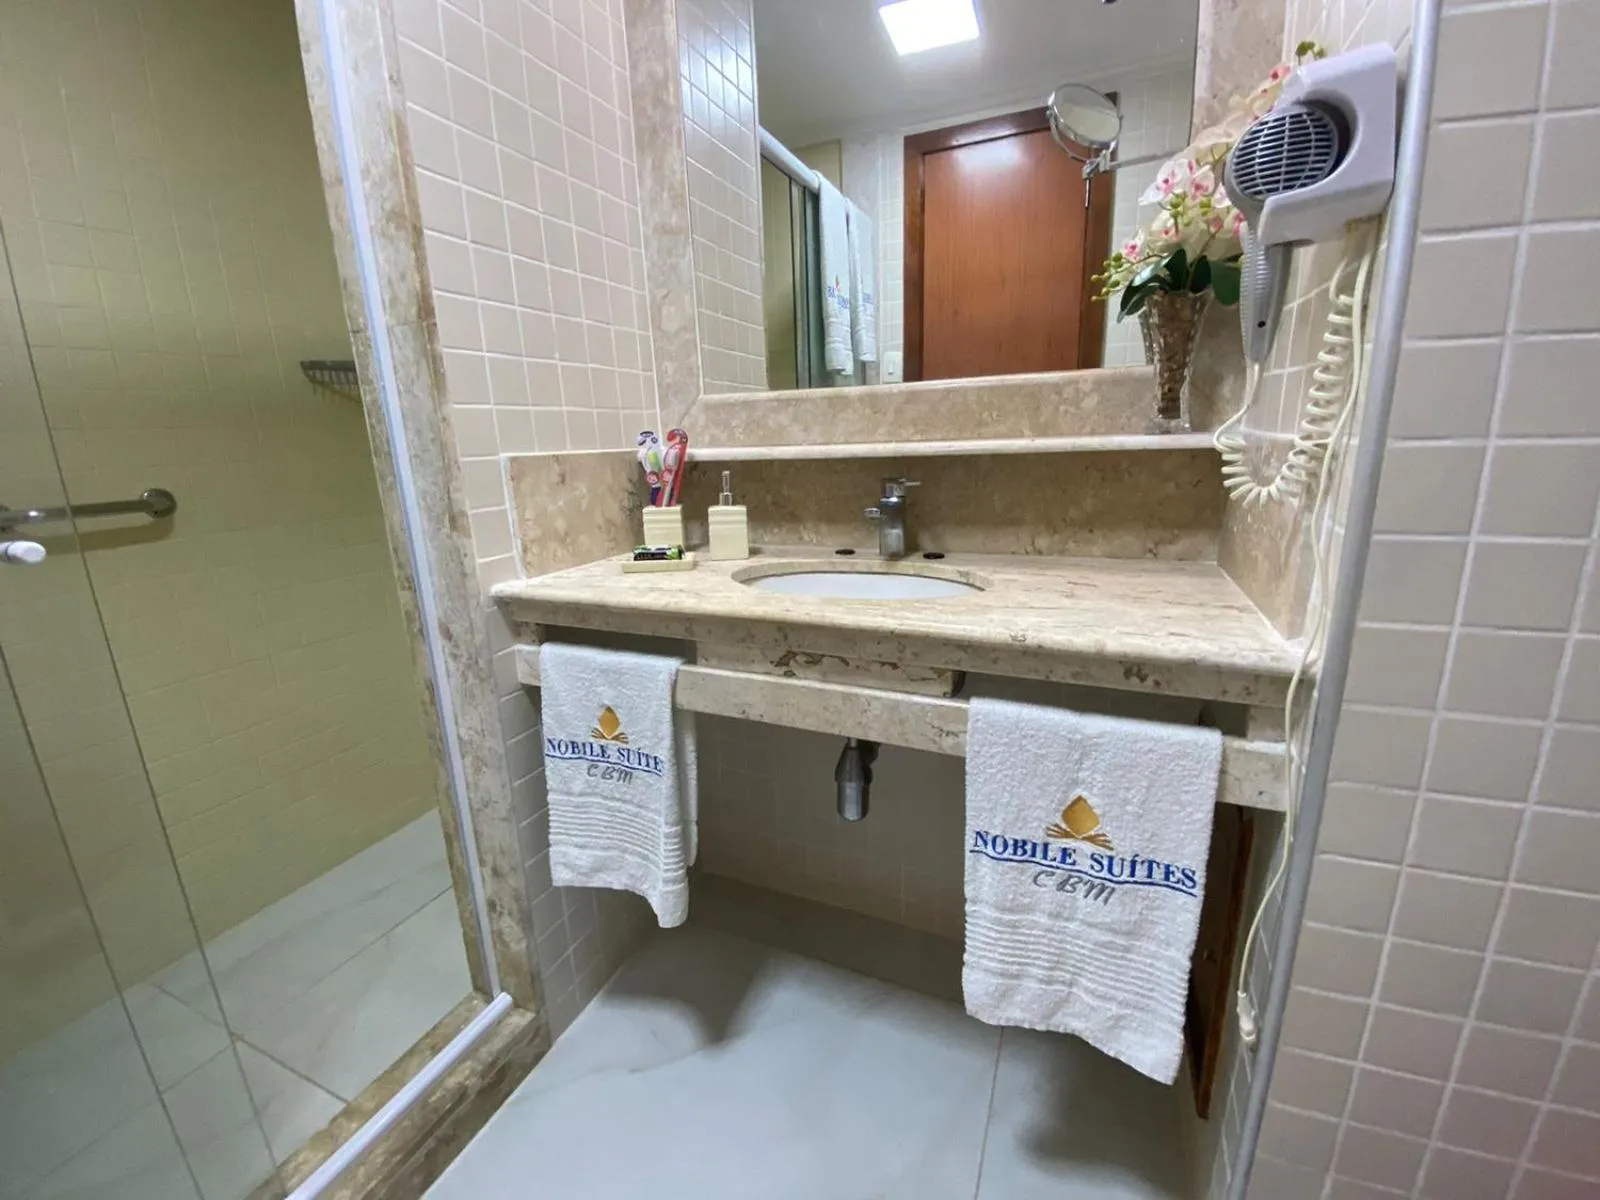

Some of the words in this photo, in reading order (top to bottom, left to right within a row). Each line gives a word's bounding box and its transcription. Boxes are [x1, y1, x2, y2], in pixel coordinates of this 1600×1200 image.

[546, 738, 611, 760] NOBILE
[617, 747, 664, 773] SUÍTE
[973, 830, 1077, 866] NOBILE
[1090, 853, 1197, 889] SUÍTES
